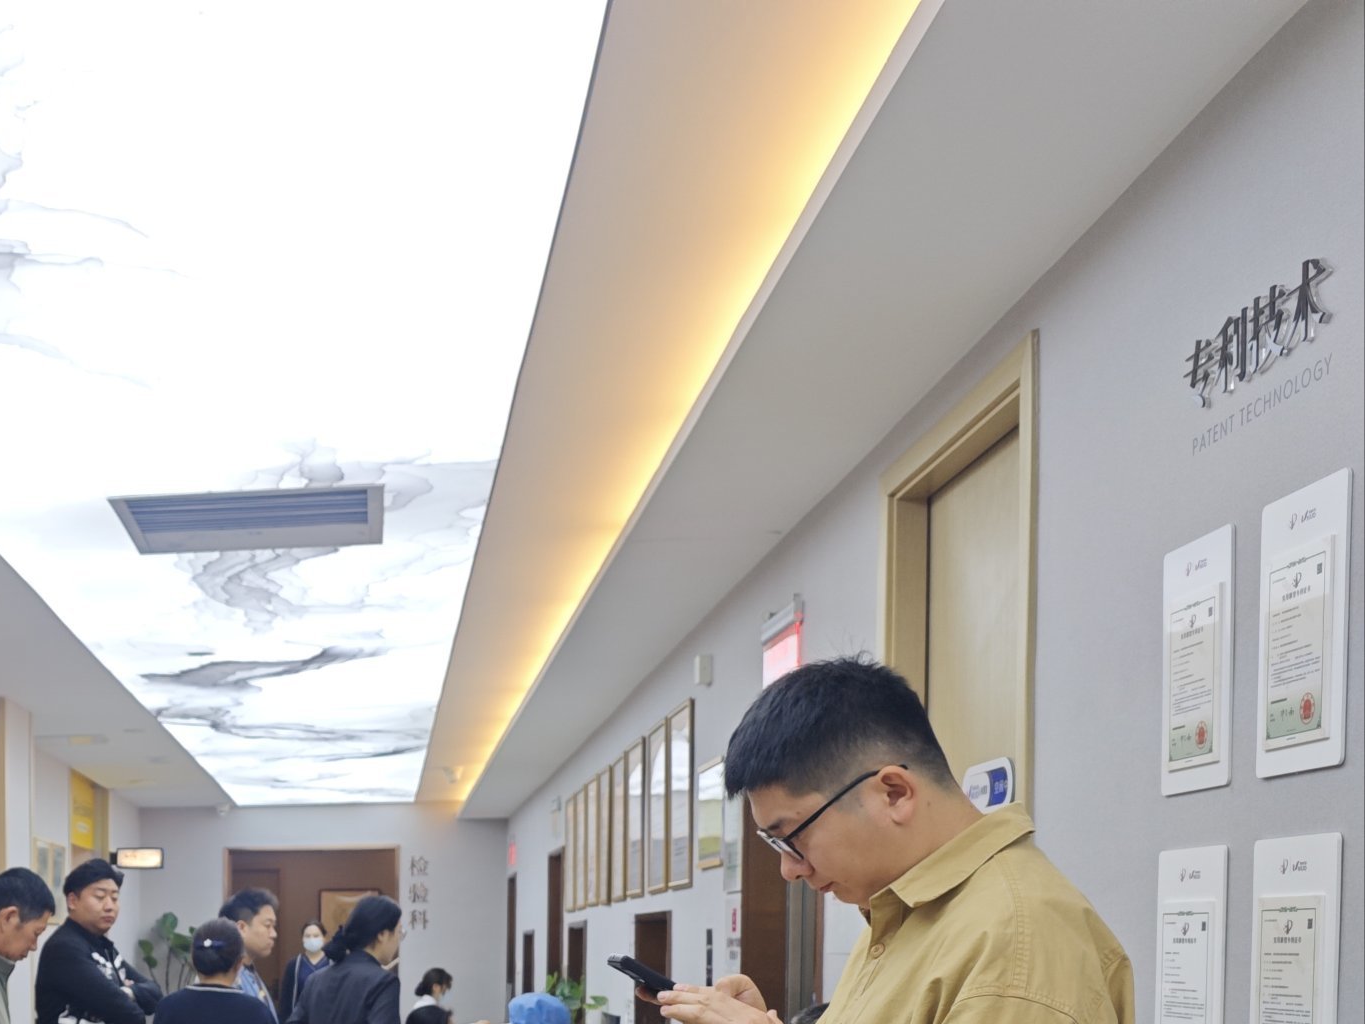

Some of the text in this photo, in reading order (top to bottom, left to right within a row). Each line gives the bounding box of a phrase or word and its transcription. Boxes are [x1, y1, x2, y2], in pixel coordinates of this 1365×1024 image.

[1183, 258, 1333, 408] 专利技术
[1191, 351, 1333, 456] PATENT TECHNOLOGY
[409, 855, 429, 930] 检验科
